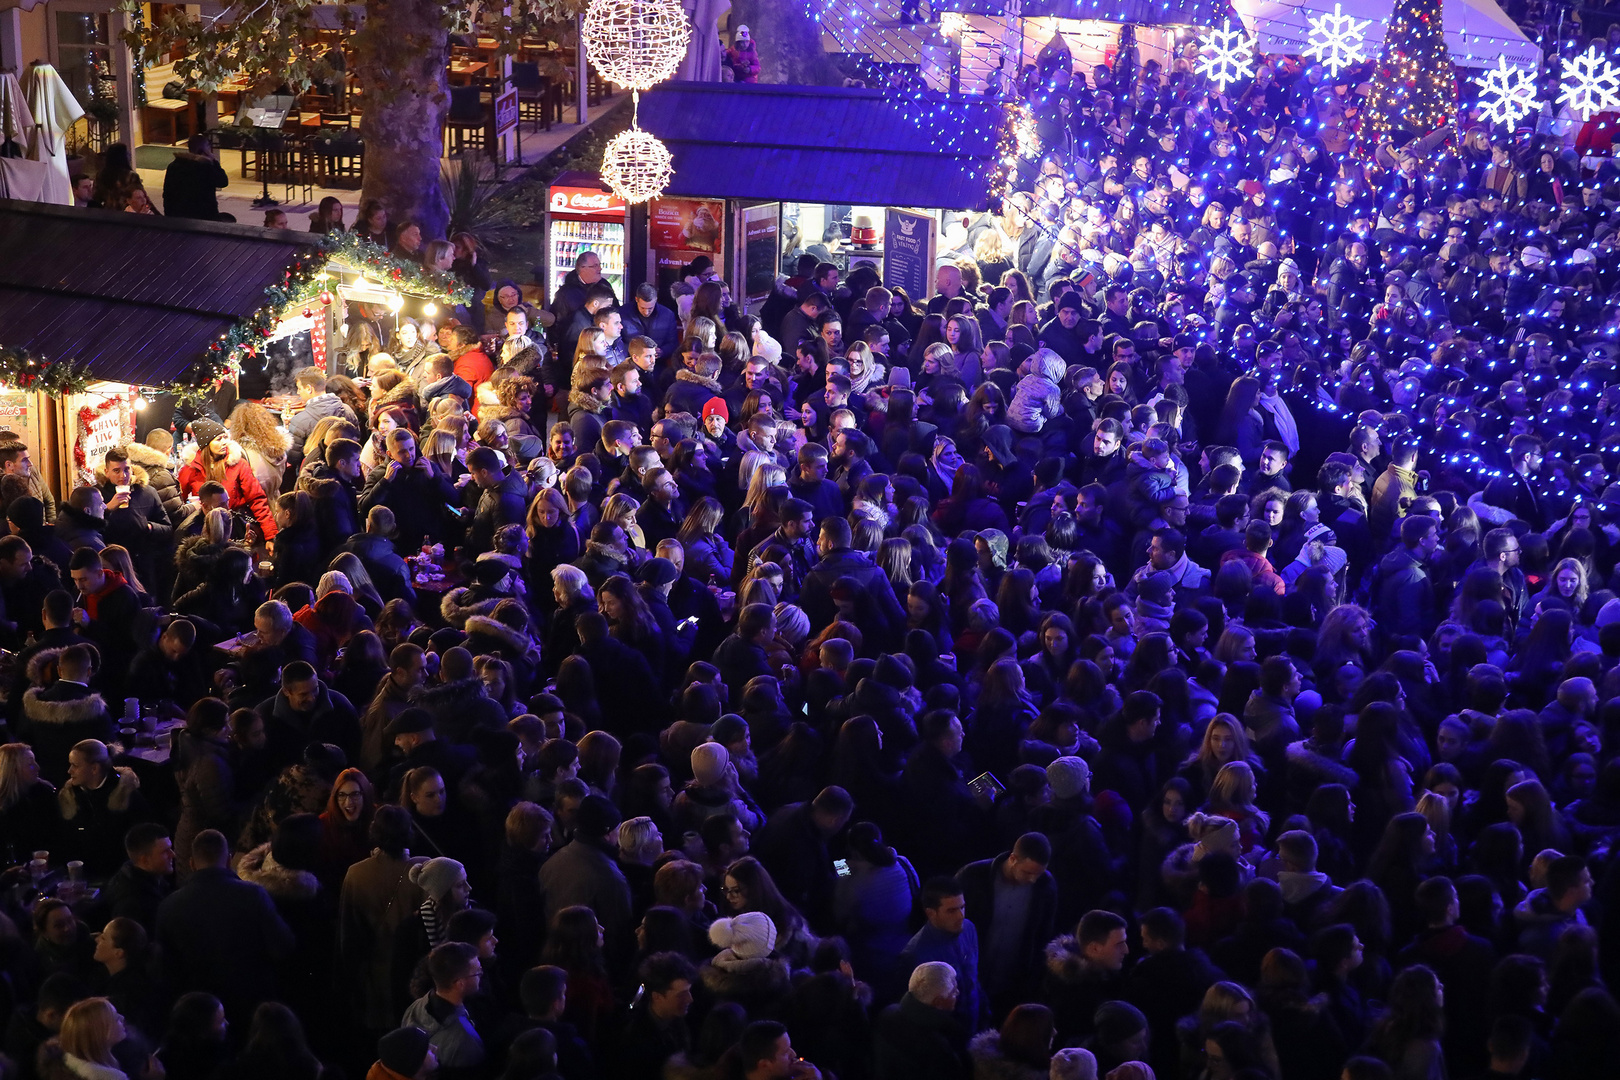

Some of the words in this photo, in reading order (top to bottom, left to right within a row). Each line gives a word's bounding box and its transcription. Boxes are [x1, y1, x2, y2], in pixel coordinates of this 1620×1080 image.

[1490, 52, 1533, 63] Jmnica
[905, 236, 917, 244] FOOD
[658, 257, 682, 265] Advent
